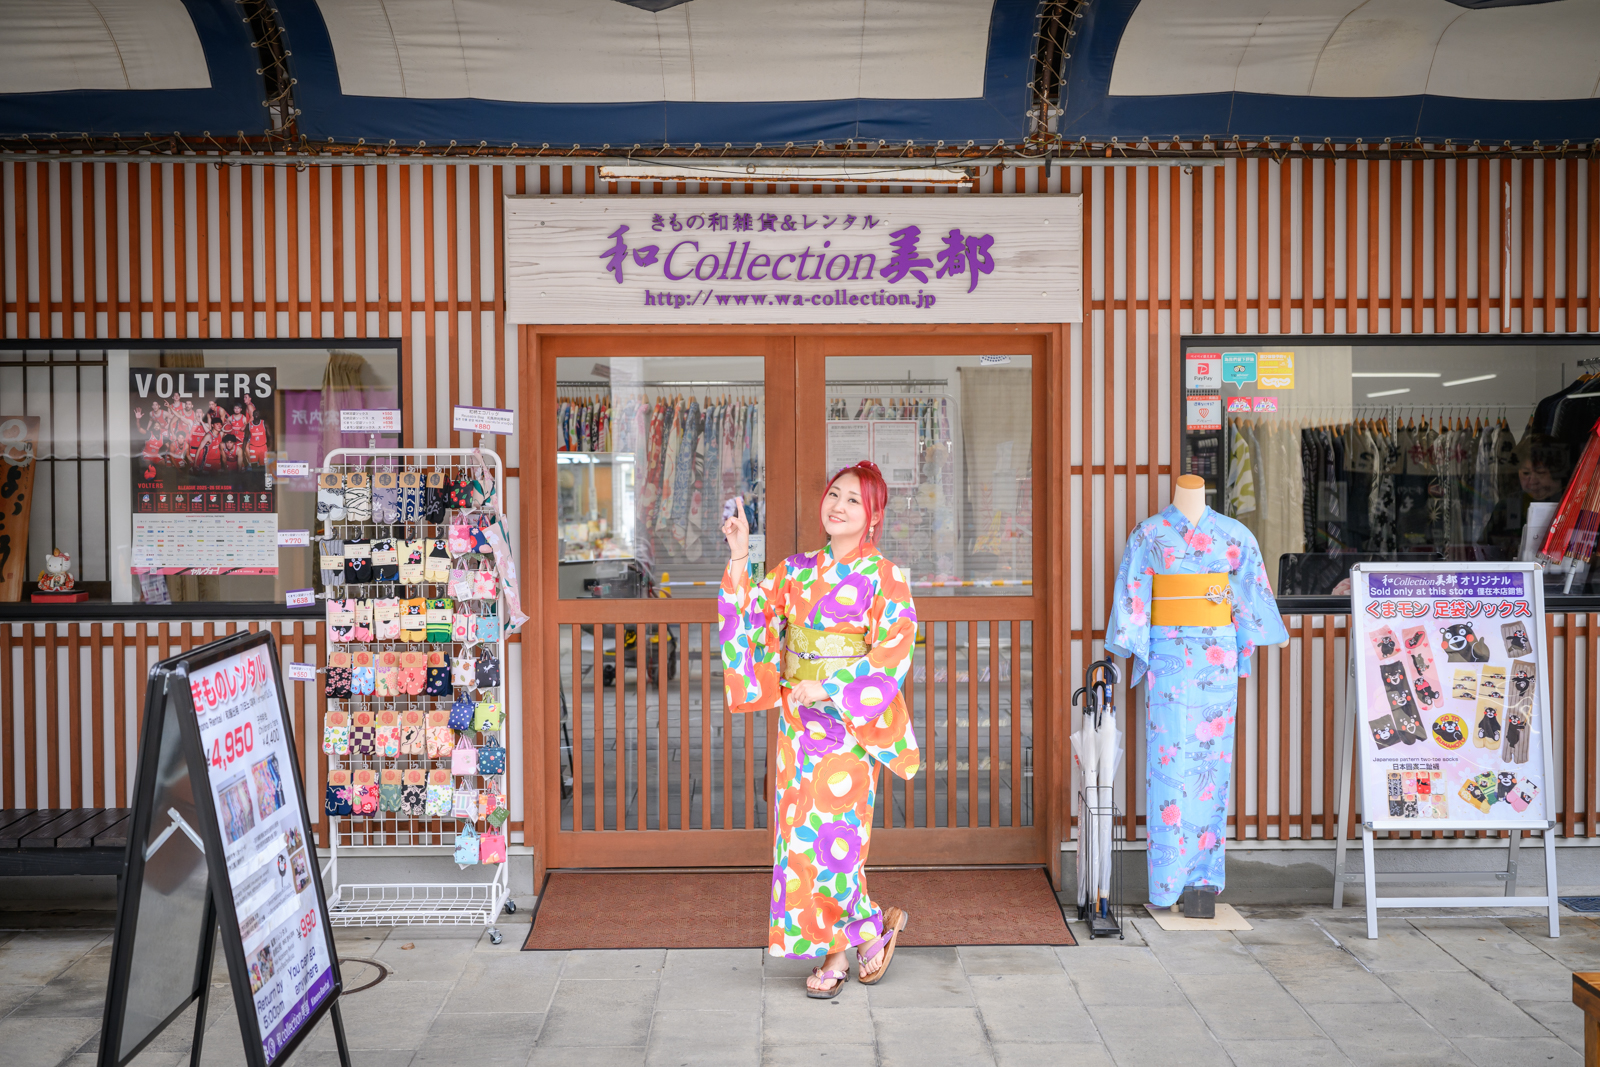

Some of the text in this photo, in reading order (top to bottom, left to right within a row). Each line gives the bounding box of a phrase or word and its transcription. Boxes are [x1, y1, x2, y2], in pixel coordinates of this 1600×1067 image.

[651, 212, 880, 232] きもの和雑貨&レンタル
[644, 288, 937, 310] http://www.wa-collection.jp
[135, 373, 272, 398] VOLTERS
[1461, 576, 1511, 586] オリジナル
[293, 596, 308, 604] ¥638
[1370, 587, 1391, 596] Sold
[1393, 587, 1414, 598] only
[1416, 588, 1427, 596] at
[1429, 587, 1447, 596] this
[1449, 588, 1474, 596] store
[1366, 600, 1531, 618] くまモン 足袋ソックス
[190, 653, 266, 712] きものレンタル
[263, 728, 280, 747] ¥4,400
[1435, 736, 1466, 749] KUMAMOTO
[297, 909, 317, 940] ¥990
[287, 959, 300, 982] You
[299, 950, 309, 970] can
[308, 944, 316, 962] go
[294, 963, 318, 995] anywhere
[256, 976, 284, 1017] Return by
